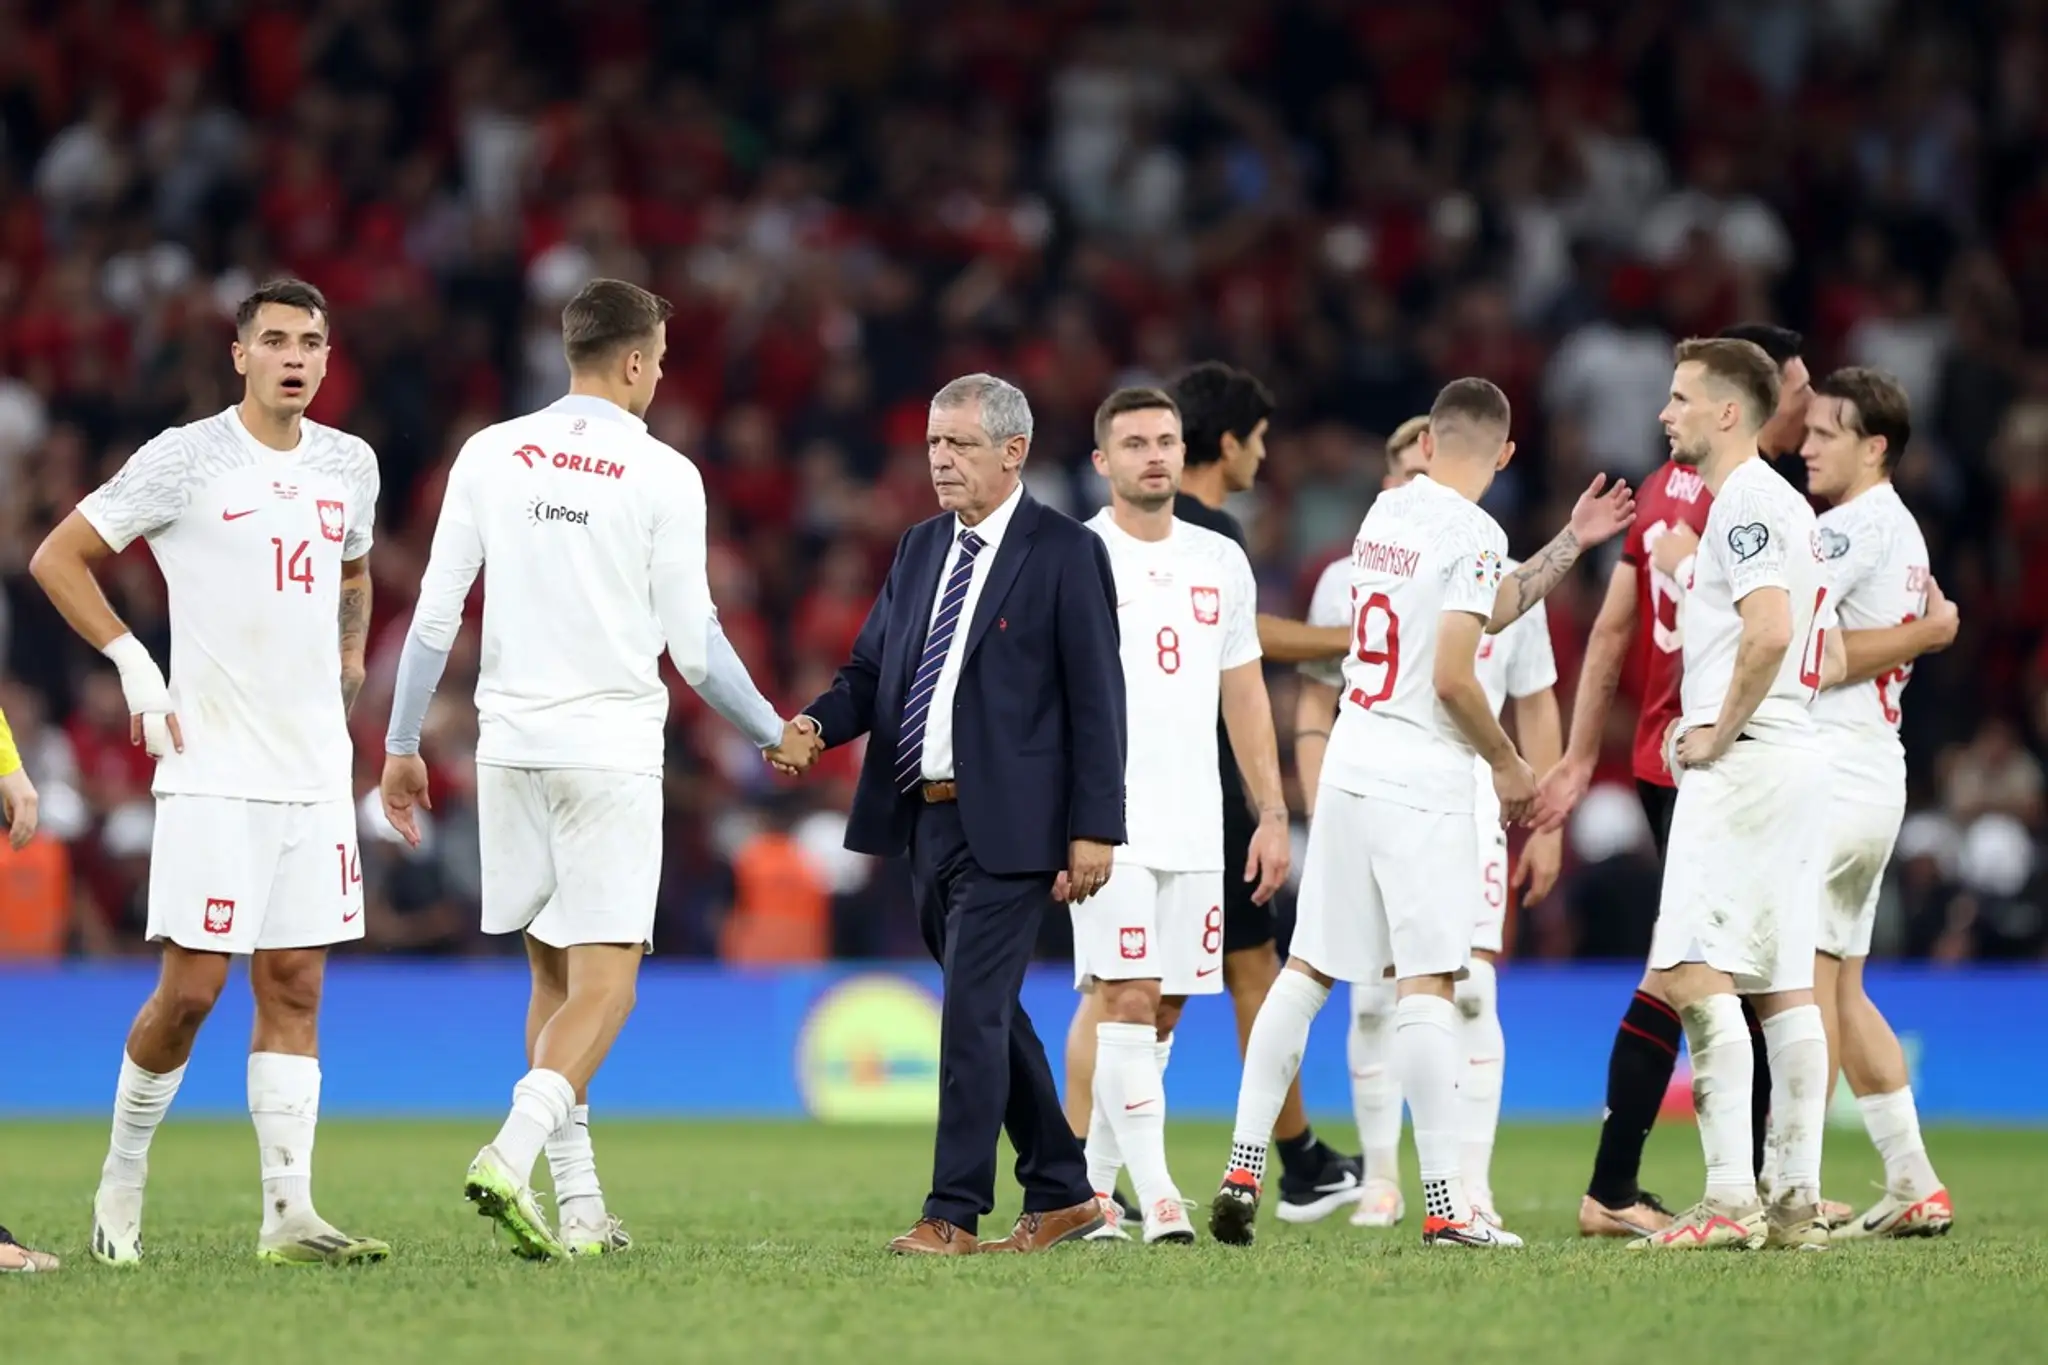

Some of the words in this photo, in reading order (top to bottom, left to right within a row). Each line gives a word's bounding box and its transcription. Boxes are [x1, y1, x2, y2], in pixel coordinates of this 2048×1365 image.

[552, 452, 625, 479] ORLEN
[545, 504, 589, 525] InPost
[271, 537, 314, 594] 14
[1156, 626, 1180, 674] 8
[336, 843, 361, 896] 14
[1485, 862, 1503, 908] 5
[1203, 905, 1223, 954] 8
